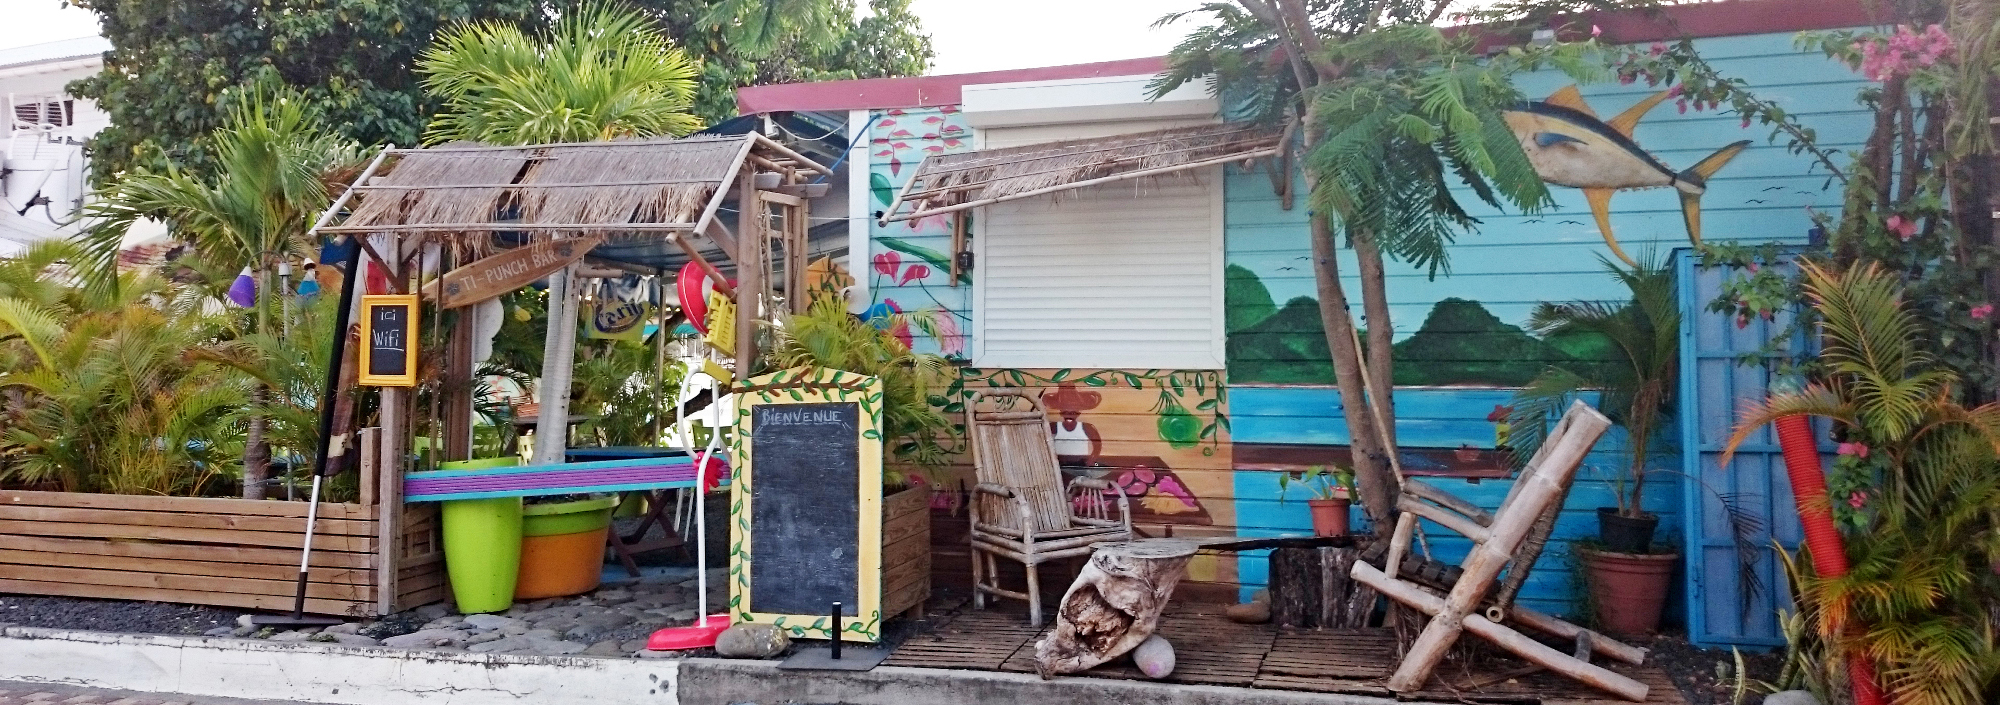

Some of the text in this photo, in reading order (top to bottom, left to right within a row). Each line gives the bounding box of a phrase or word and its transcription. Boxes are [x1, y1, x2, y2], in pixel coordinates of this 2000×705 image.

[460, 250, 557, 291] TI-PUNCH BAR
[380, 307, 396, 321] ici
